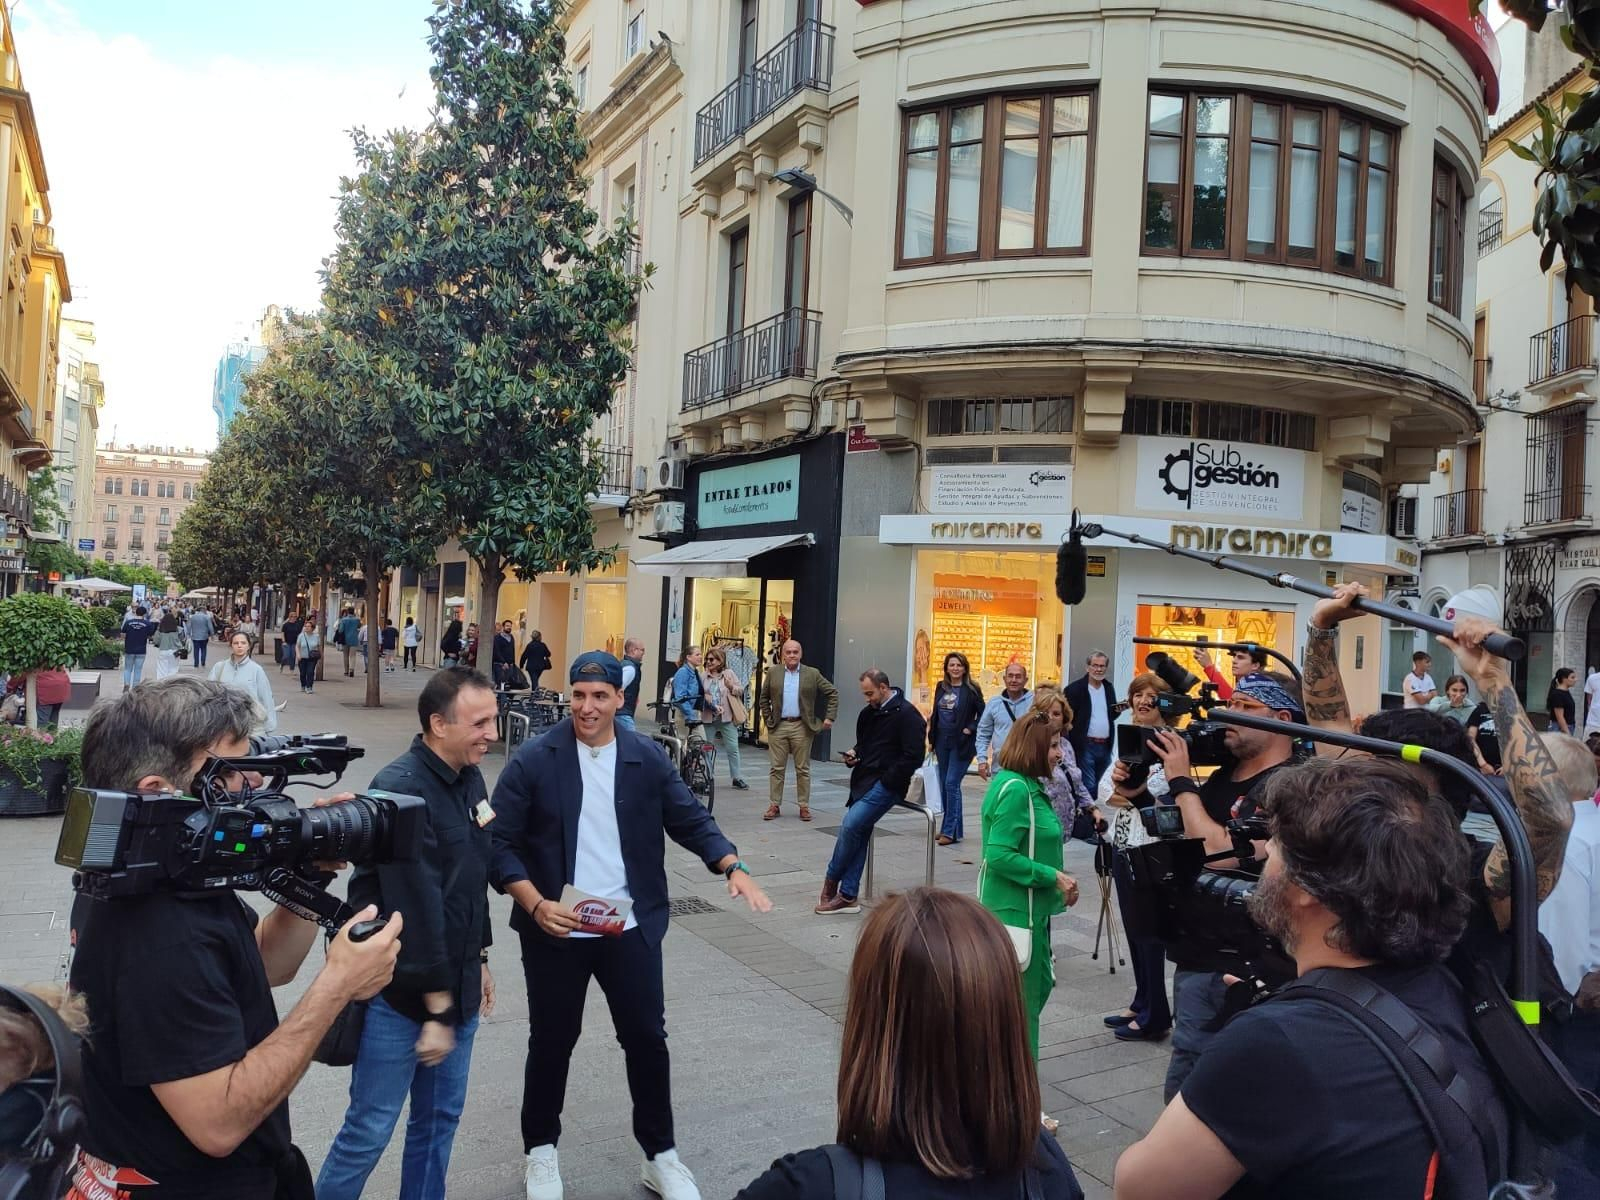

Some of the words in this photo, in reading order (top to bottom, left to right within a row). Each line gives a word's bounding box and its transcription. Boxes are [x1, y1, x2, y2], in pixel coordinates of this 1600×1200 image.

[1195, 442, 1242, 467] Sub
[1194, 461, 1280, 489] gestión
[704, 487, 740, 503] ENTRE
[744, 479, 792, 498] TRAPOS
[1192, 490, 1234, 500] GESTIÓN
[1237, 493, 1280, 504] INTEGRAL
[1192, 499, 1205, 507] DE
[1209, 500, 1279, 512] SUBVENCIONES
[931, 522, 1042, 538] miramira
[1171, 524, 1333, 558] miramira
[295, 886, 315, 900] SONY
